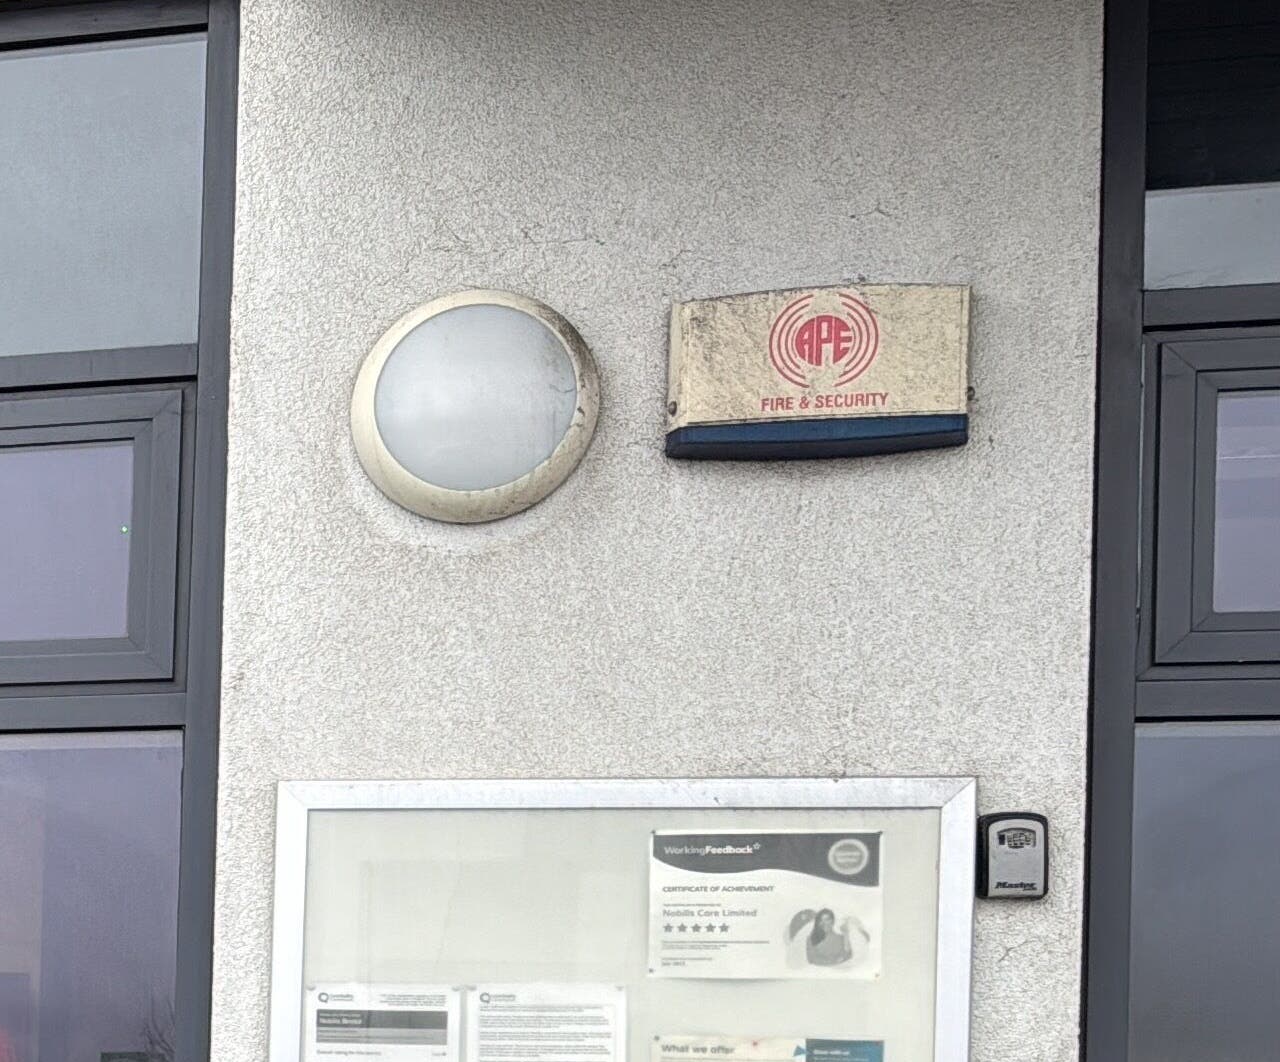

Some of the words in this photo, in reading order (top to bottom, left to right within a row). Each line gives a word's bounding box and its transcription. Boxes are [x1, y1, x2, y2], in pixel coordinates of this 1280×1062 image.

[795, 314, 853, 367] APE
[760, 396, 794, 412] FIRE
[799, 395, 810, 409] &
[814, 392, 890, 410] SECURITY
